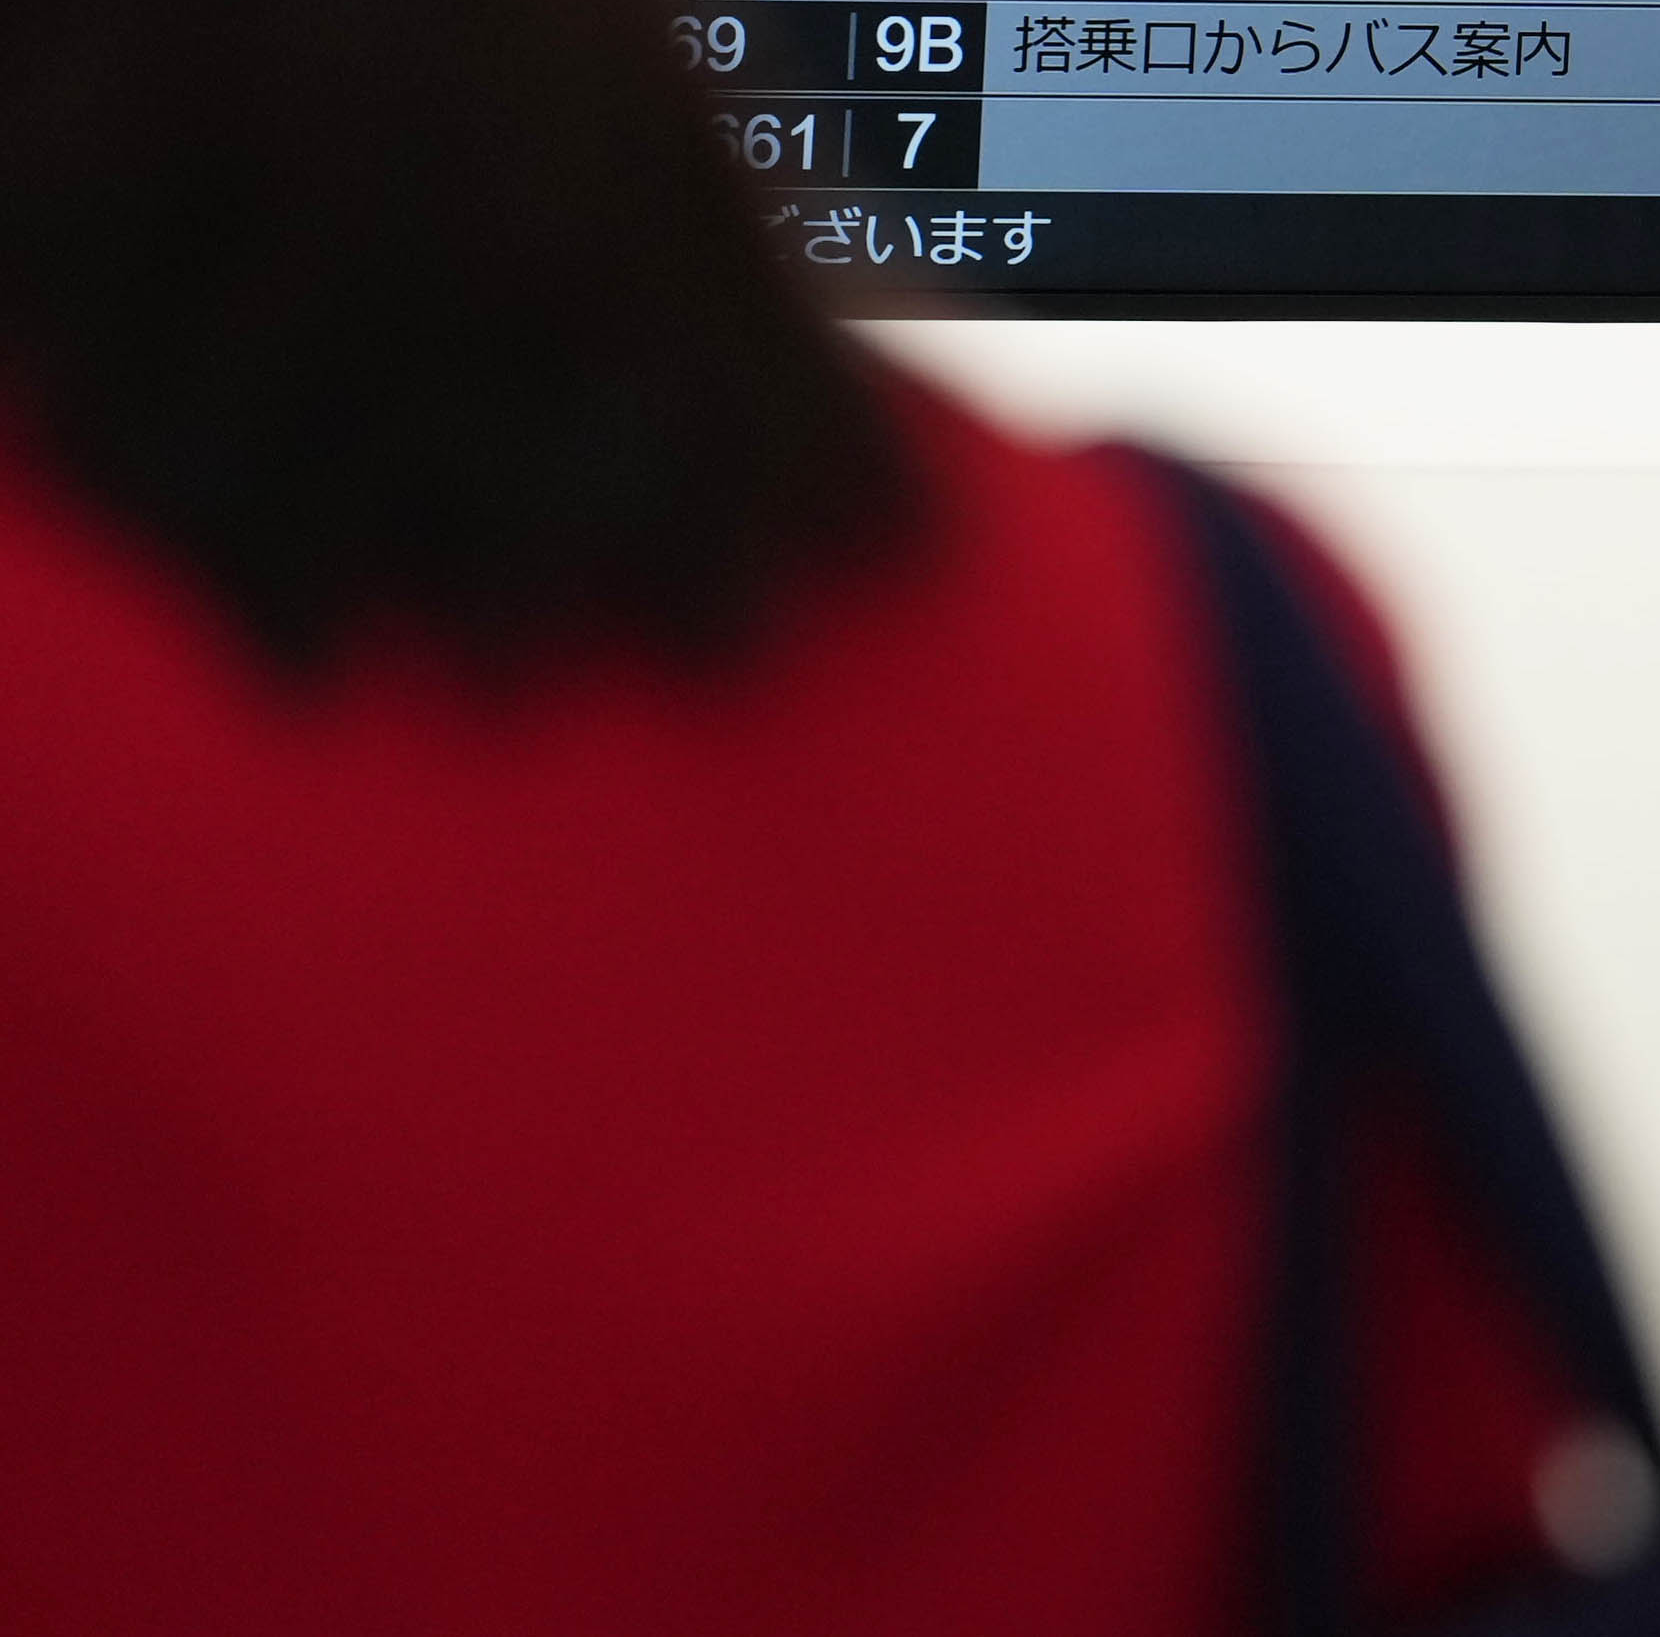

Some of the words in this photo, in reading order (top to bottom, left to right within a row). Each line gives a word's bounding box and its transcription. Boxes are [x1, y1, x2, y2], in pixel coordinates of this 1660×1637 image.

[876, 15, 963, 73] 9B
[1013, 15, 1571, 79] 搭乗口からバス案内
[897, 112, 937, 169] 7
